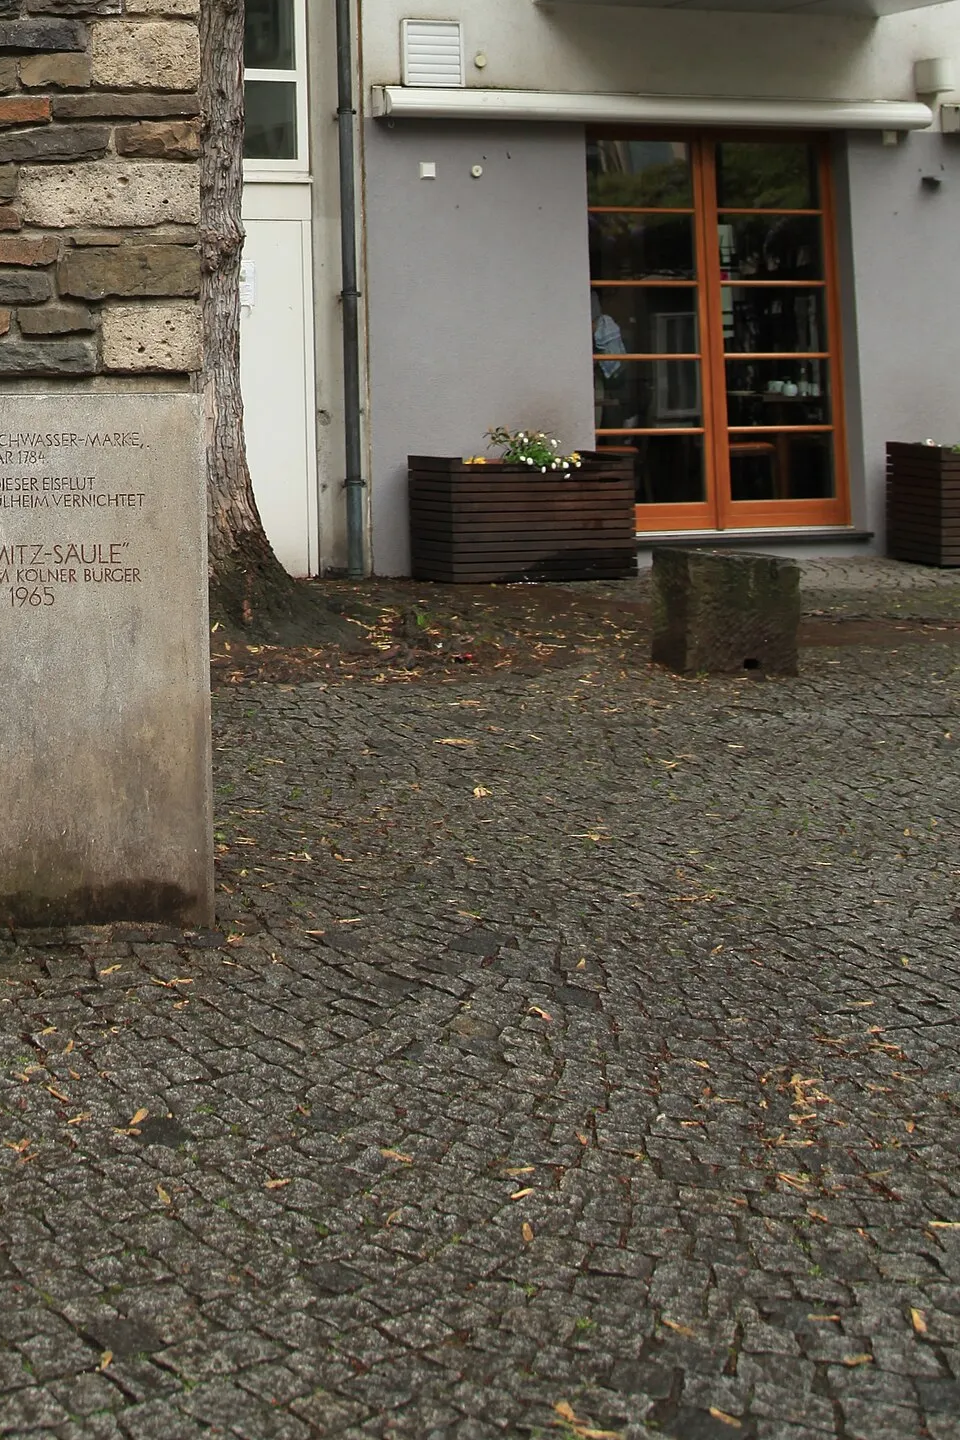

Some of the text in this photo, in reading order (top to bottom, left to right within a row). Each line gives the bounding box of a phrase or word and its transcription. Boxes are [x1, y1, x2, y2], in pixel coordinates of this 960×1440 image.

[42, 476, 96, 491] EISFLUT
[51, 493, 146, 508] VERNICHTET
[16, 568, 78, 583] KÖLNER
[83, 567, 142, 583] BÜRGER
[9, 586, 55, 608] 1965
